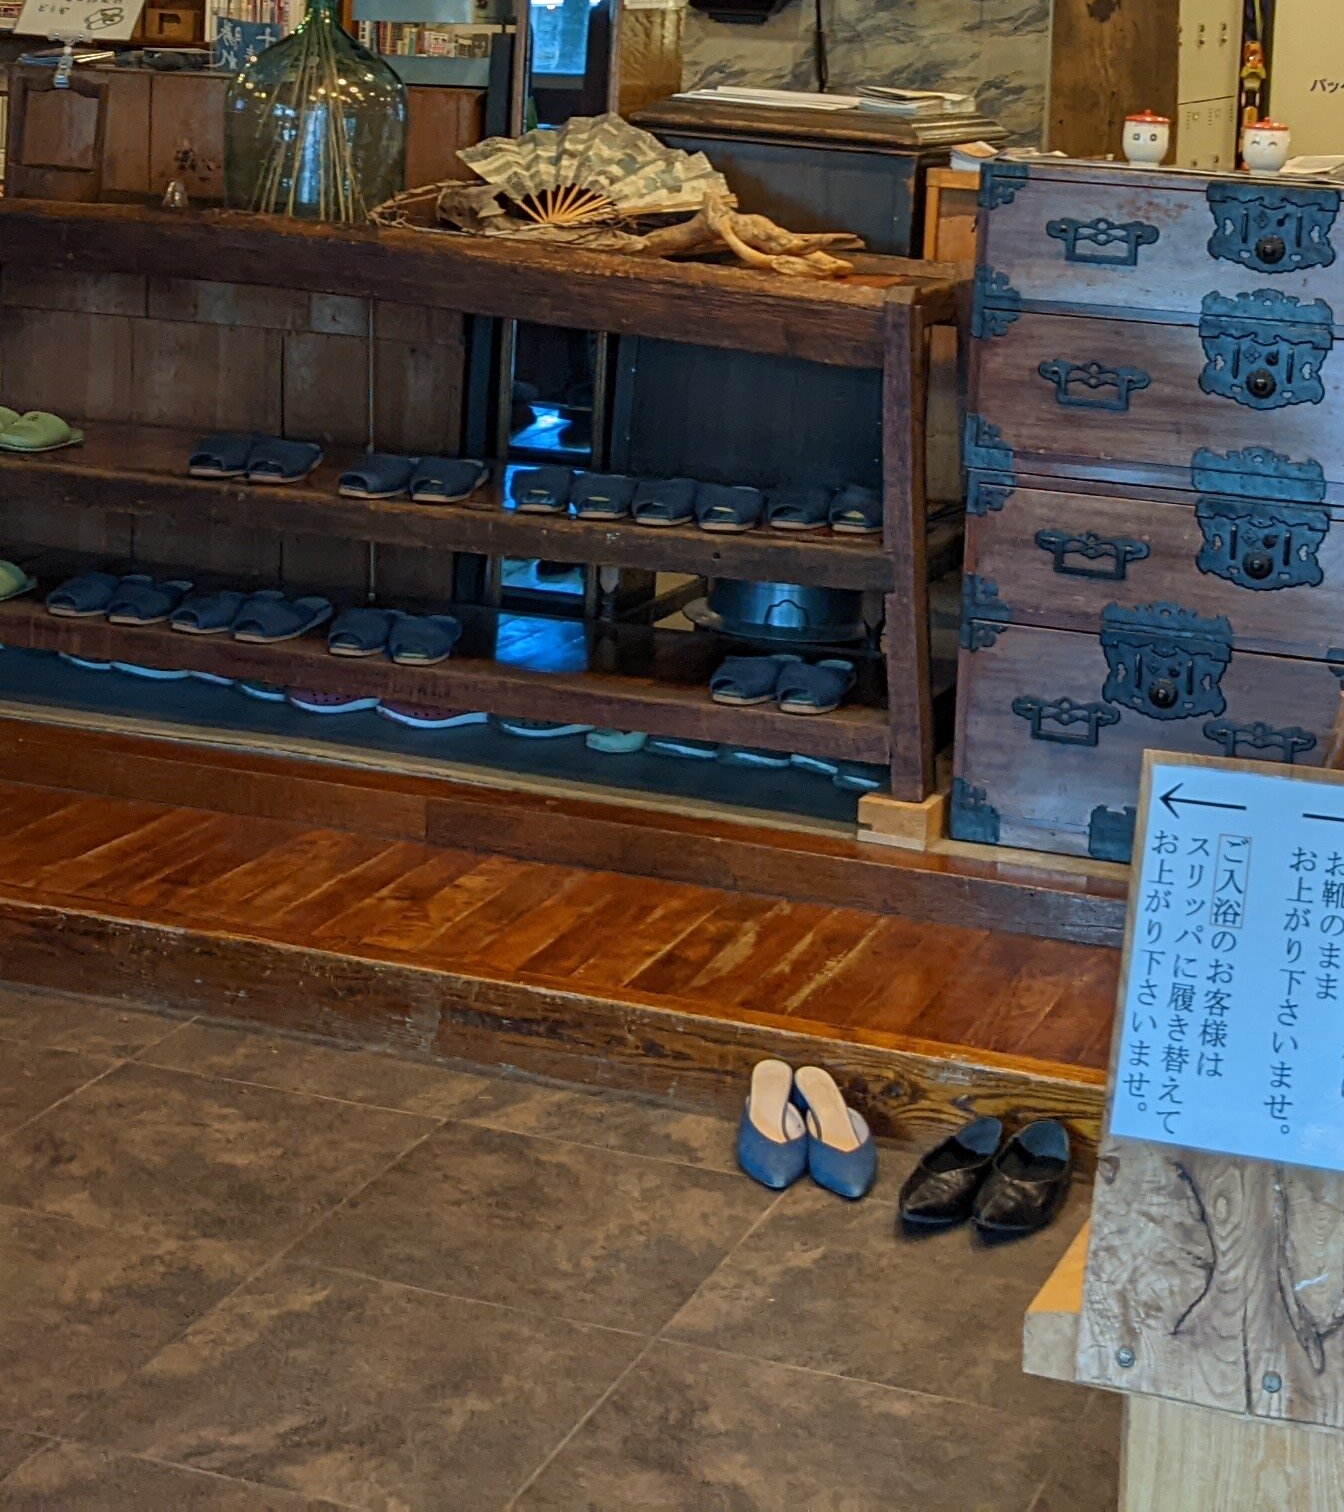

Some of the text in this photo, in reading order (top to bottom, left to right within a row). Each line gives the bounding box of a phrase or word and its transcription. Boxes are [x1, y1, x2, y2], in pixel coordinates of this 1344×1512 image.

[1122, 830, 1180, 1113] お上がり下さいませ。
[1155, 836, 1211, 1136] スリッパに履き替えて
[1196, 838, 1249, 1078] ご入浴のお客様は
[1263, 846, 1318, 1137] お上がり下さいませ。
